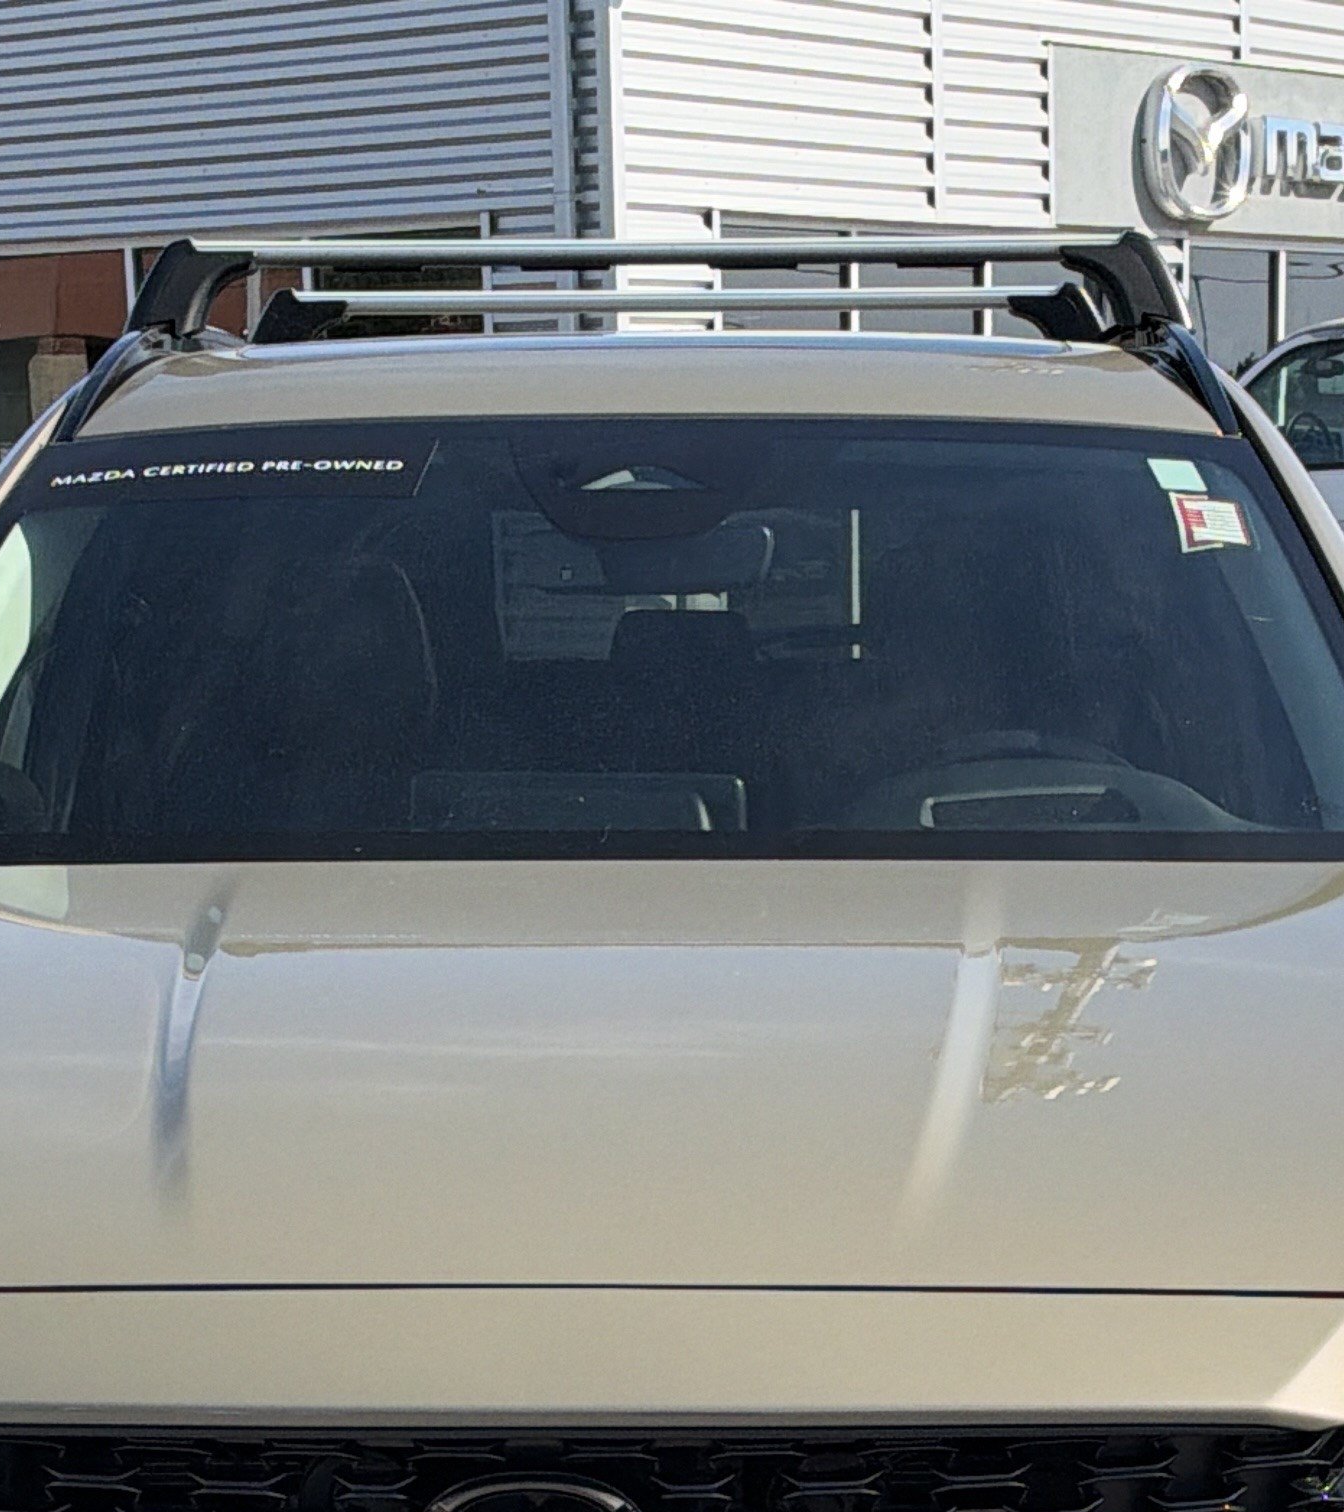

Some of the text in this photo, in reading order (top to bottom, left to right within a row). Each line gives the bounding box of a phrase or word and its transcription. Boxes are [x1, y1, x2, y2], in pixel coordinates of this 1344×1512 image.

[50, 460, 404, 488] MAZDA CERTIFIED PRE-OWNED
